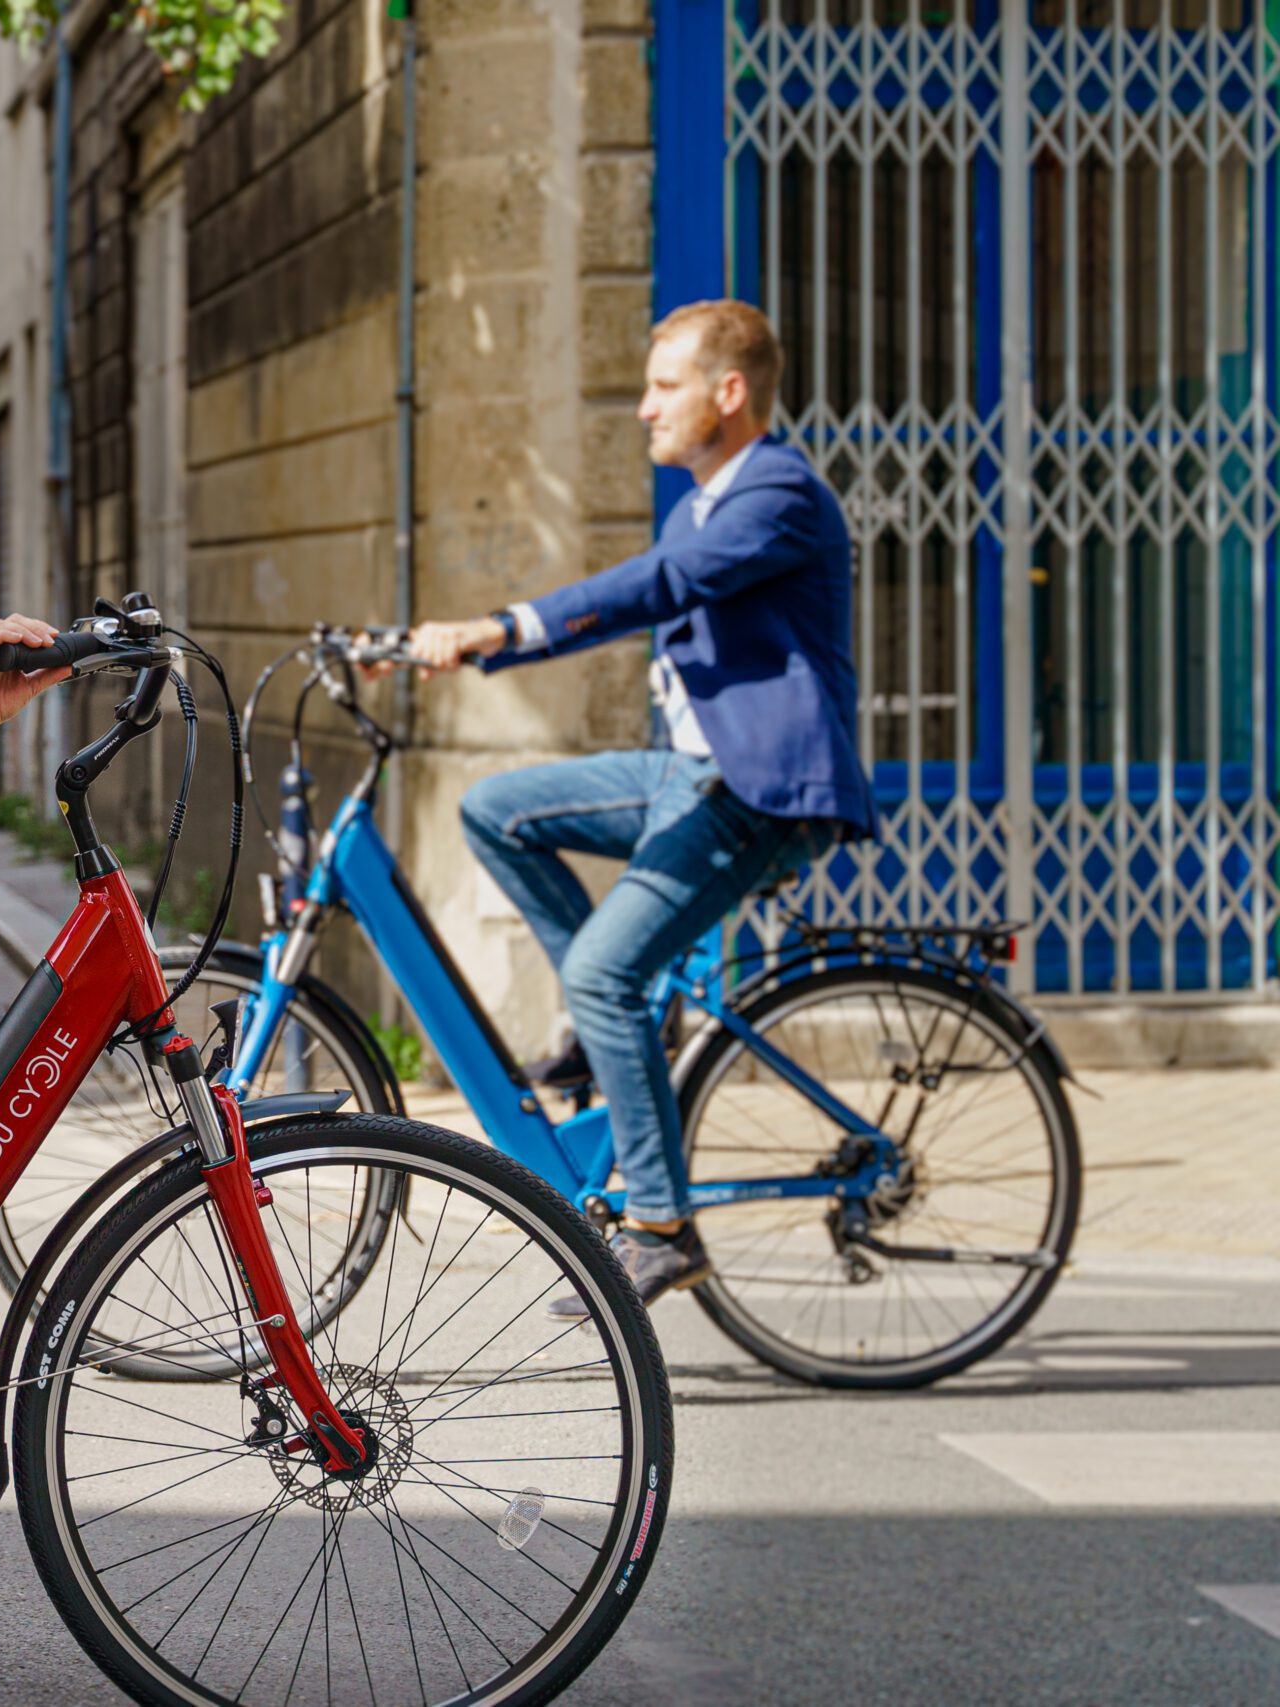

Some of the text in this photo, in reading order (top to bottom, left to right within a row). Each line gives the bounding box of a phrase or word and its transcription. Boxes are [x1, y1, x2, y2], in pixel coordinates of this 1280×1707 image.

[93, 735, 119, 761] PROMAX
[37, 1299, 76, 1390] CST COMP
